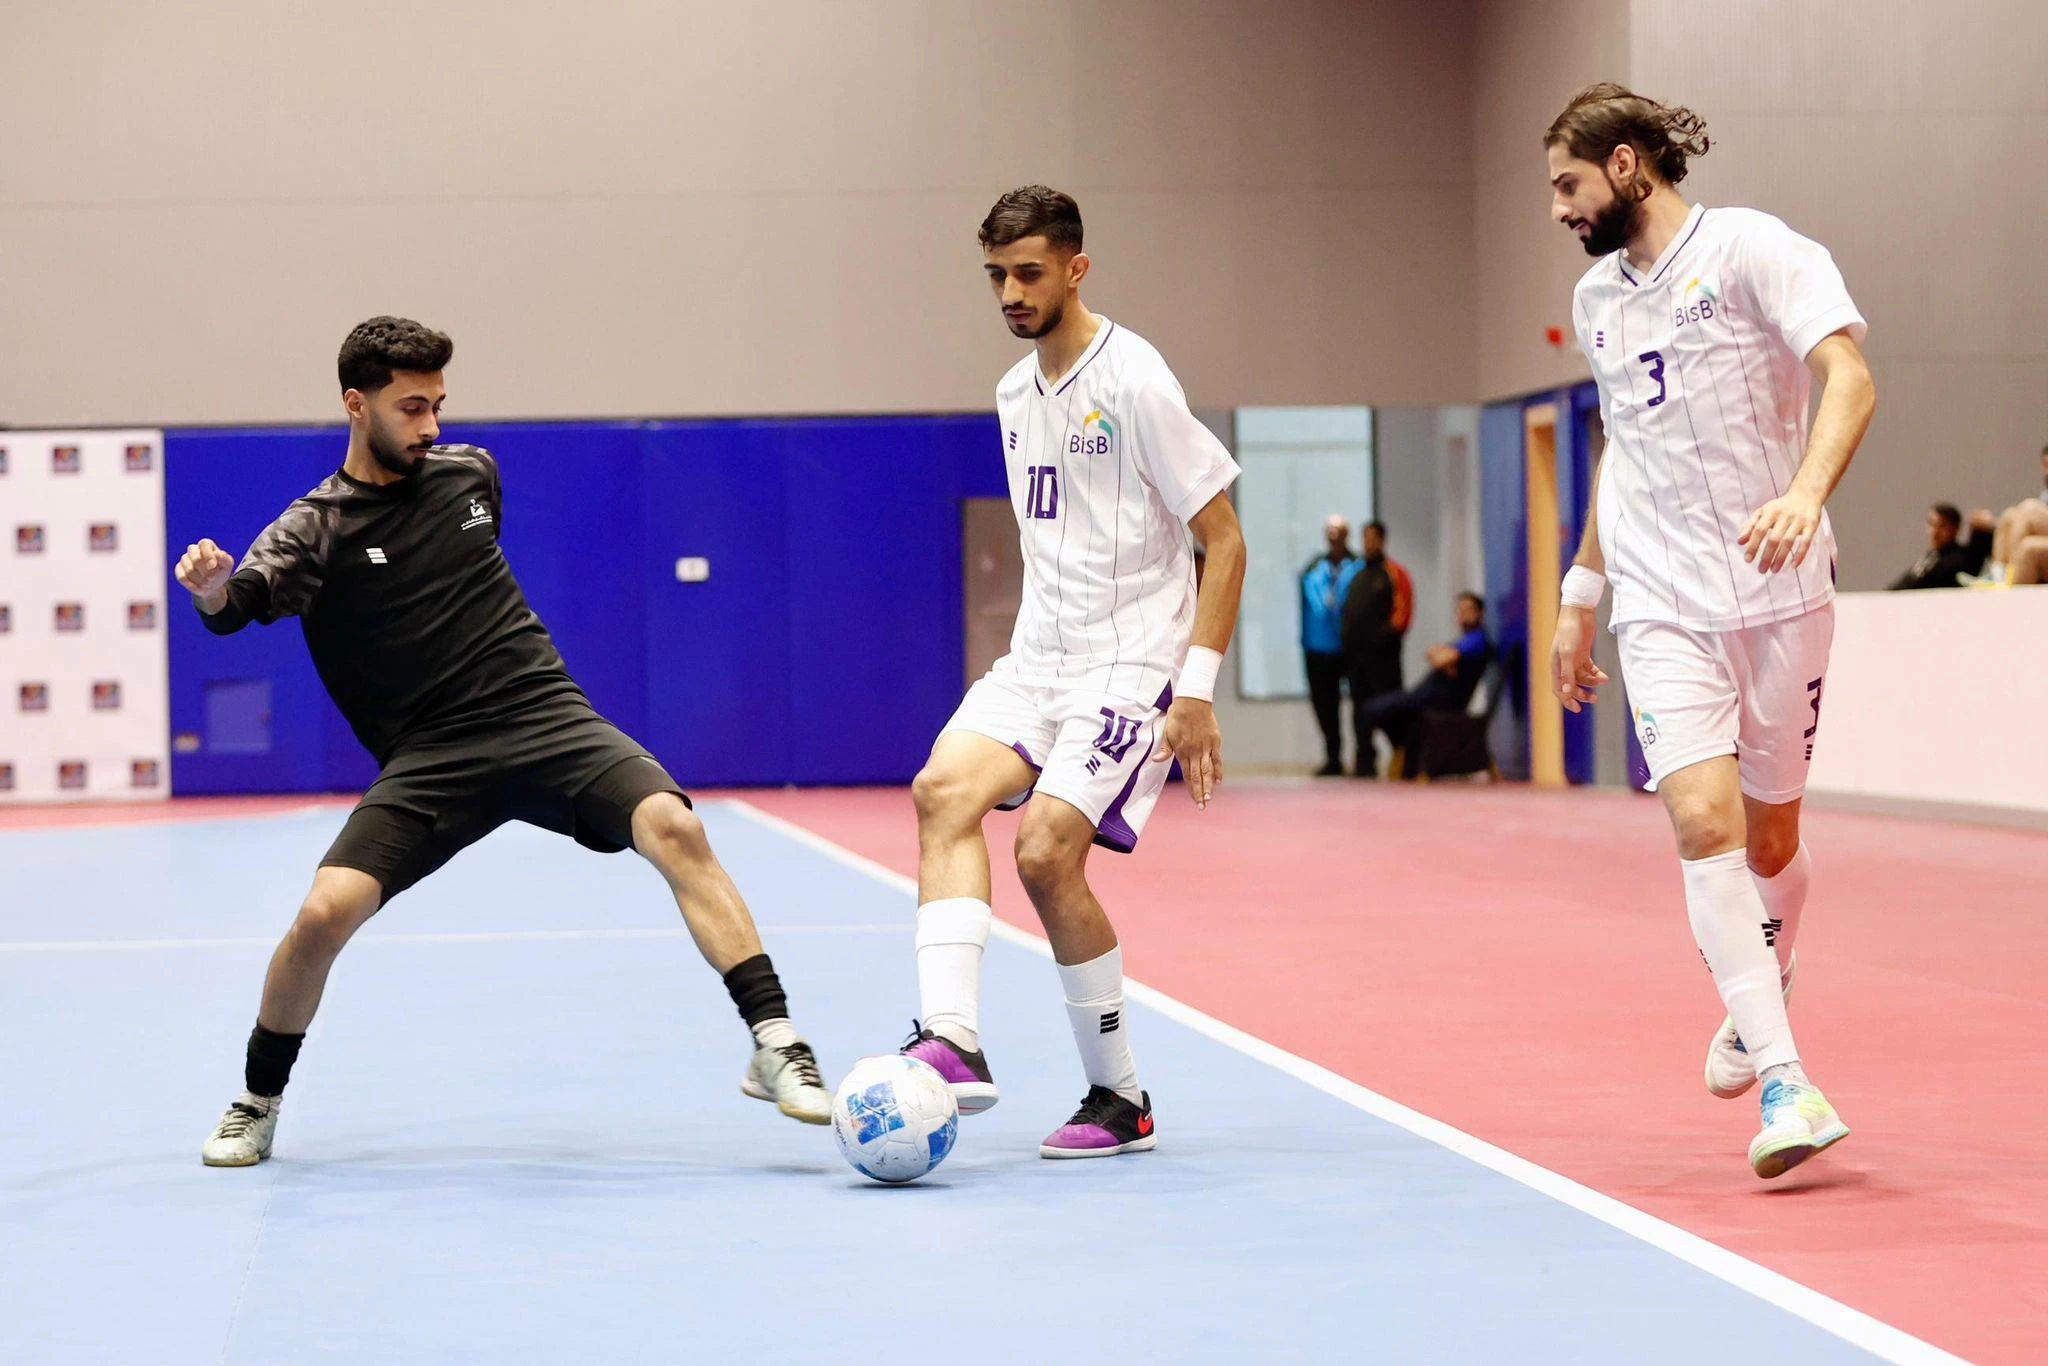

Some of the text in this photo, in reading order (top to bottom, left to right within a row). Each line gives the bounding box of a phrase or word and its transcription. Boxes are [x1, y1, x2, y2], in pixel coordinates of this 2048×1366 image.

[1675, 300, 1713, 327] BisB
[1639, 350, 1667, 407] 3
[1070, 435, 1108, 454] BisB
[1026, 465, 1057, 519] 10
[1092, 706, 1143, 764] 10
[1642, 726, 1656, 750] sB
